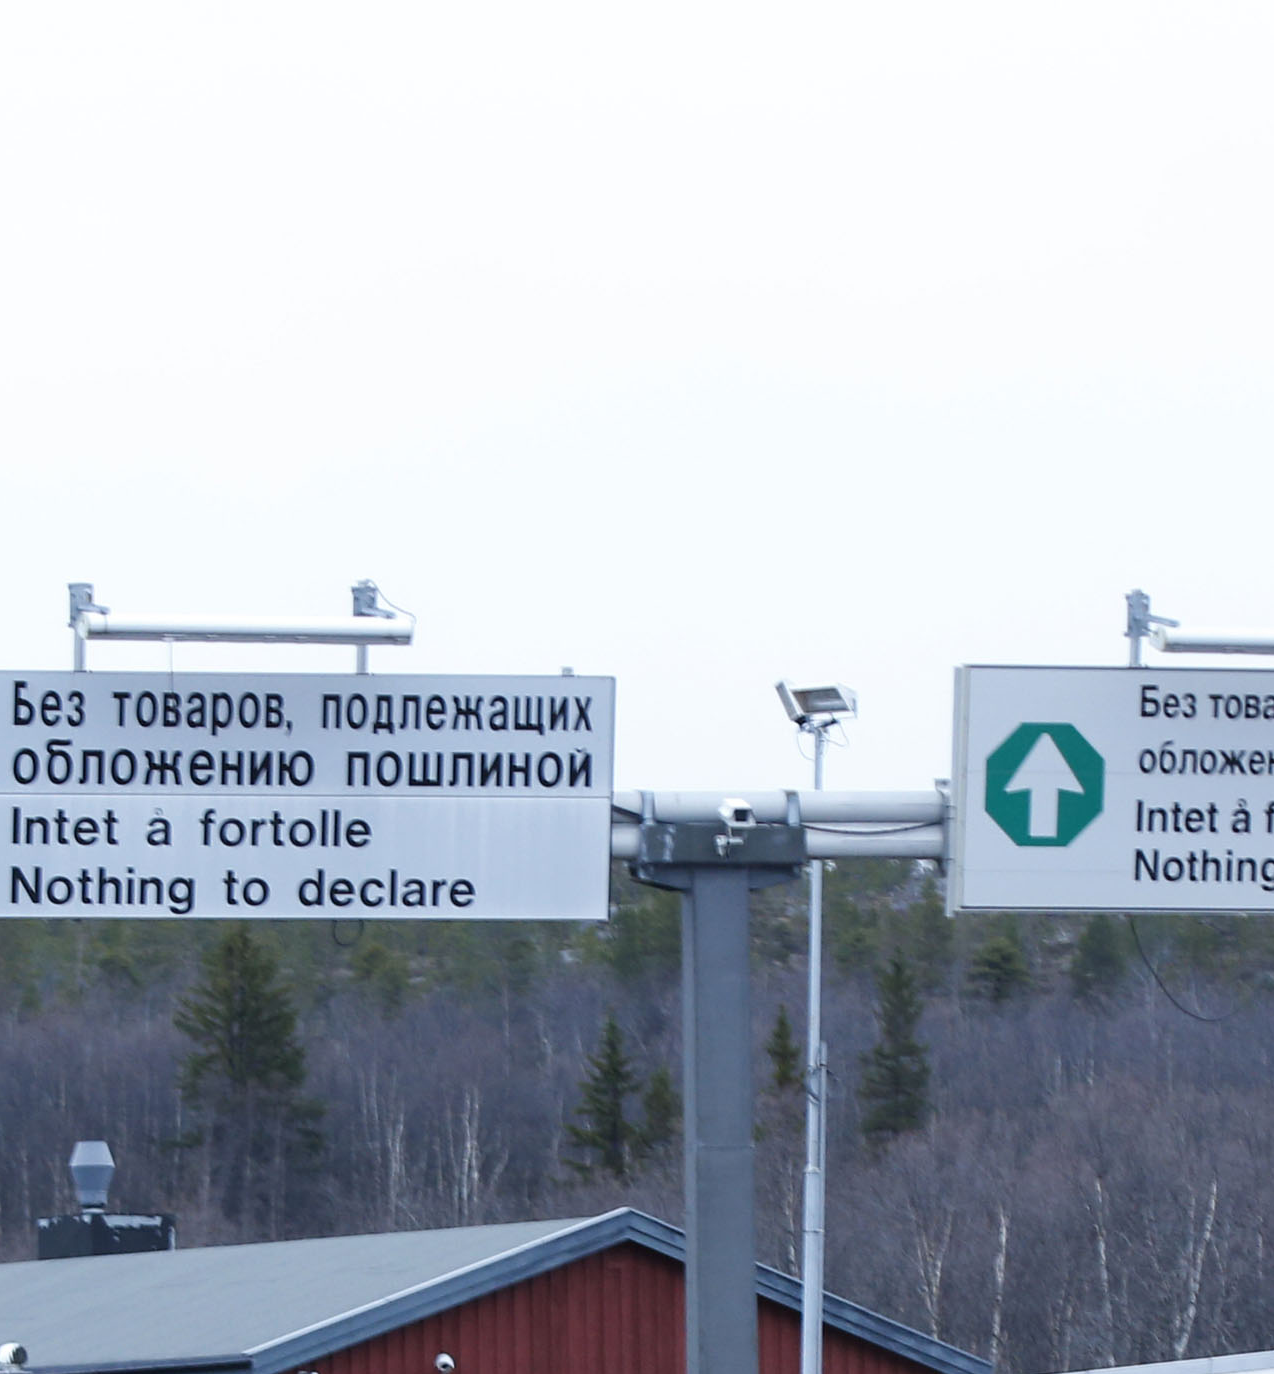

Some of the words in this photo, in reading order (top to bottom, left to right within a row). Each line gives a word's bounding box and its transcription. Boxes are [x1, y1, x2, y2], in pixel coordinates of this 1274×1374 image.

[12, 680, 86, 727] Без
[112, 690, 294, 737] товаров,
[322, 692, 593, 736] подлежащих
[1140, 684, 1197, 719] Без
[12, 738, 316, 787] обложению
[346, 747, 593, 788] пошлиной
[11, 806, 119, 847] Intet
[146, 809, 173, 847] å
[199, 808, 373, 849] fortolle
[1136, 799, 1219, 834] Intet
[1231, 798, 1252, 834] å
[10, 865, 195, 914] Nothing
[222, 869, 270, 907] to
[297, 868, 477, 908] declare
